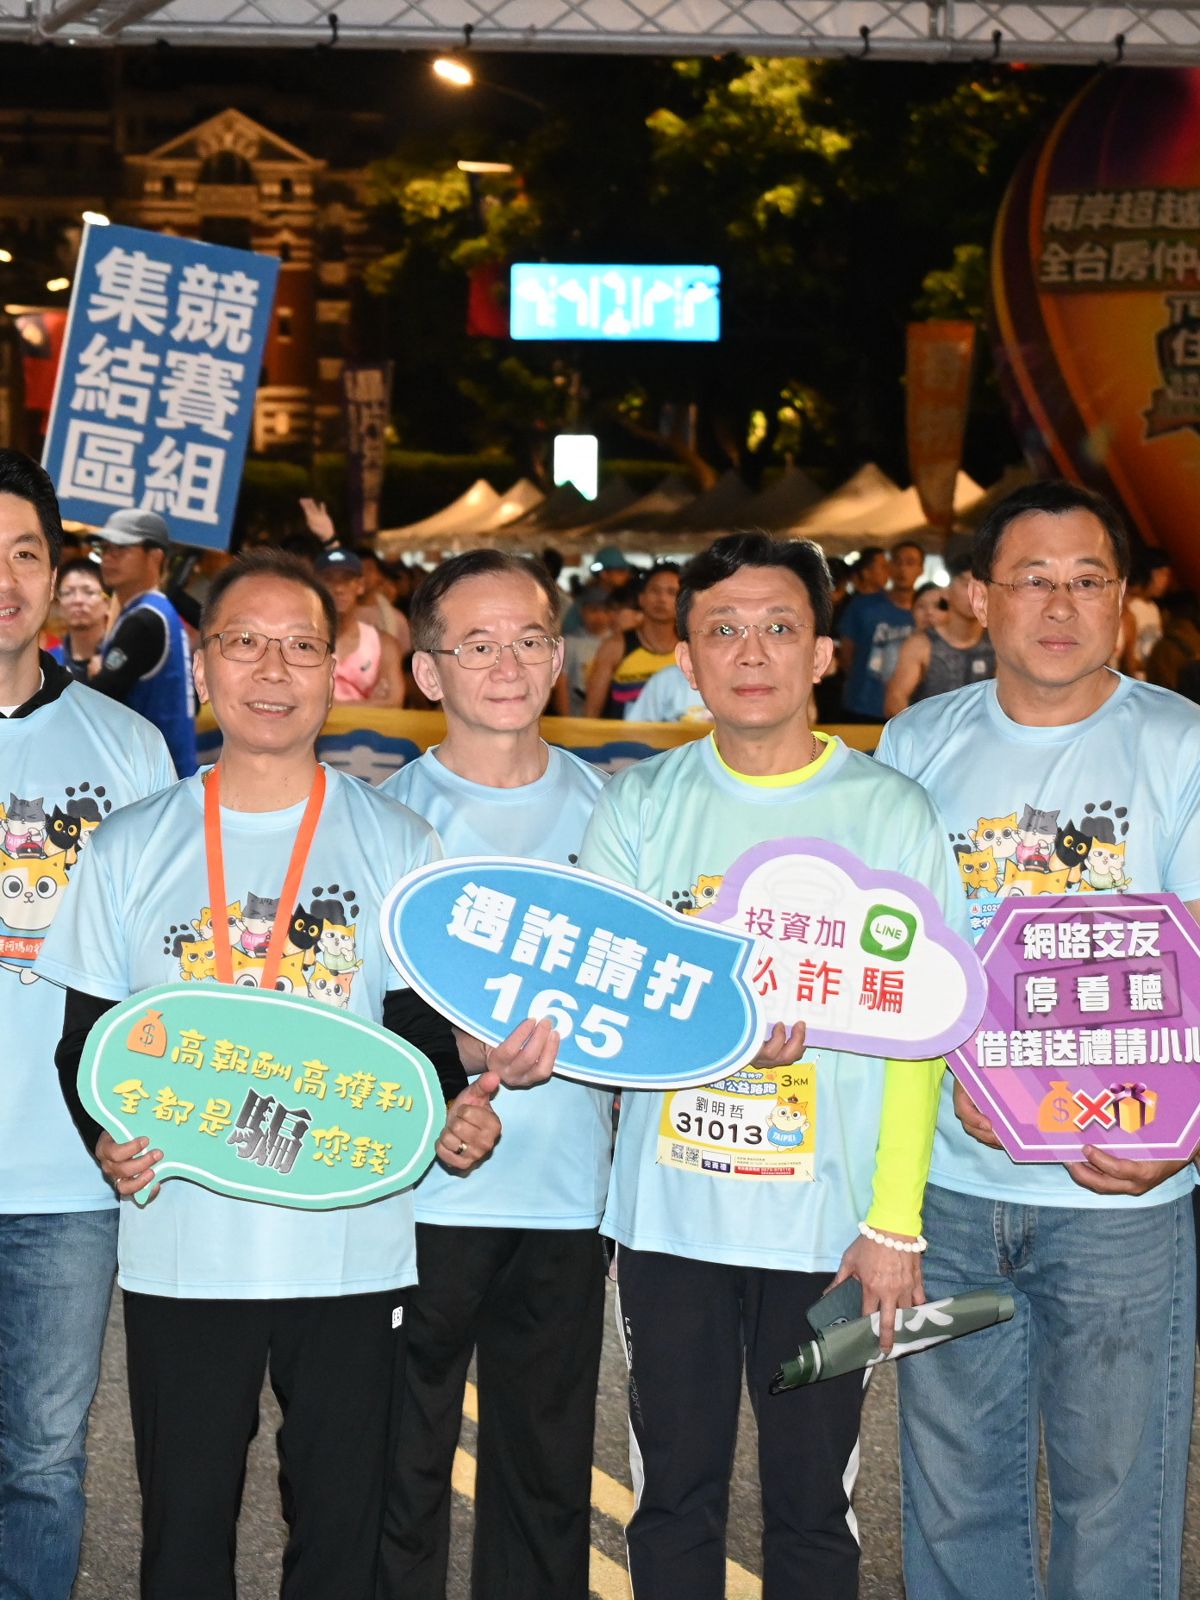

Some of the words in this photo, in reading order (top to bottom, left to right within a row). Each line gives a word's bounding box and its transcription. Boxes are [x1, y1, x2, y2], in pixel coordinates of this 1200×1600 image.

[57, 246, 172, 508] 集結區
[140, 264, 260, 525] 競賽組
[446, 881, 714, 1021] 遇詐請打
[744, 907, 846, 948] 投資加
[875, 923, 902, 940] LINE
[1023, 921, 1161, 960] 網路交友
[483, 972, 631, 1059] 165
[171, 1029, 415, 1113] 高報酬高獲利
[781, 1075, 808, 1087] 3KM
[676, 1112, 763, 1145] 31013
[695, 1096, 745, 1120] 劉明哲
